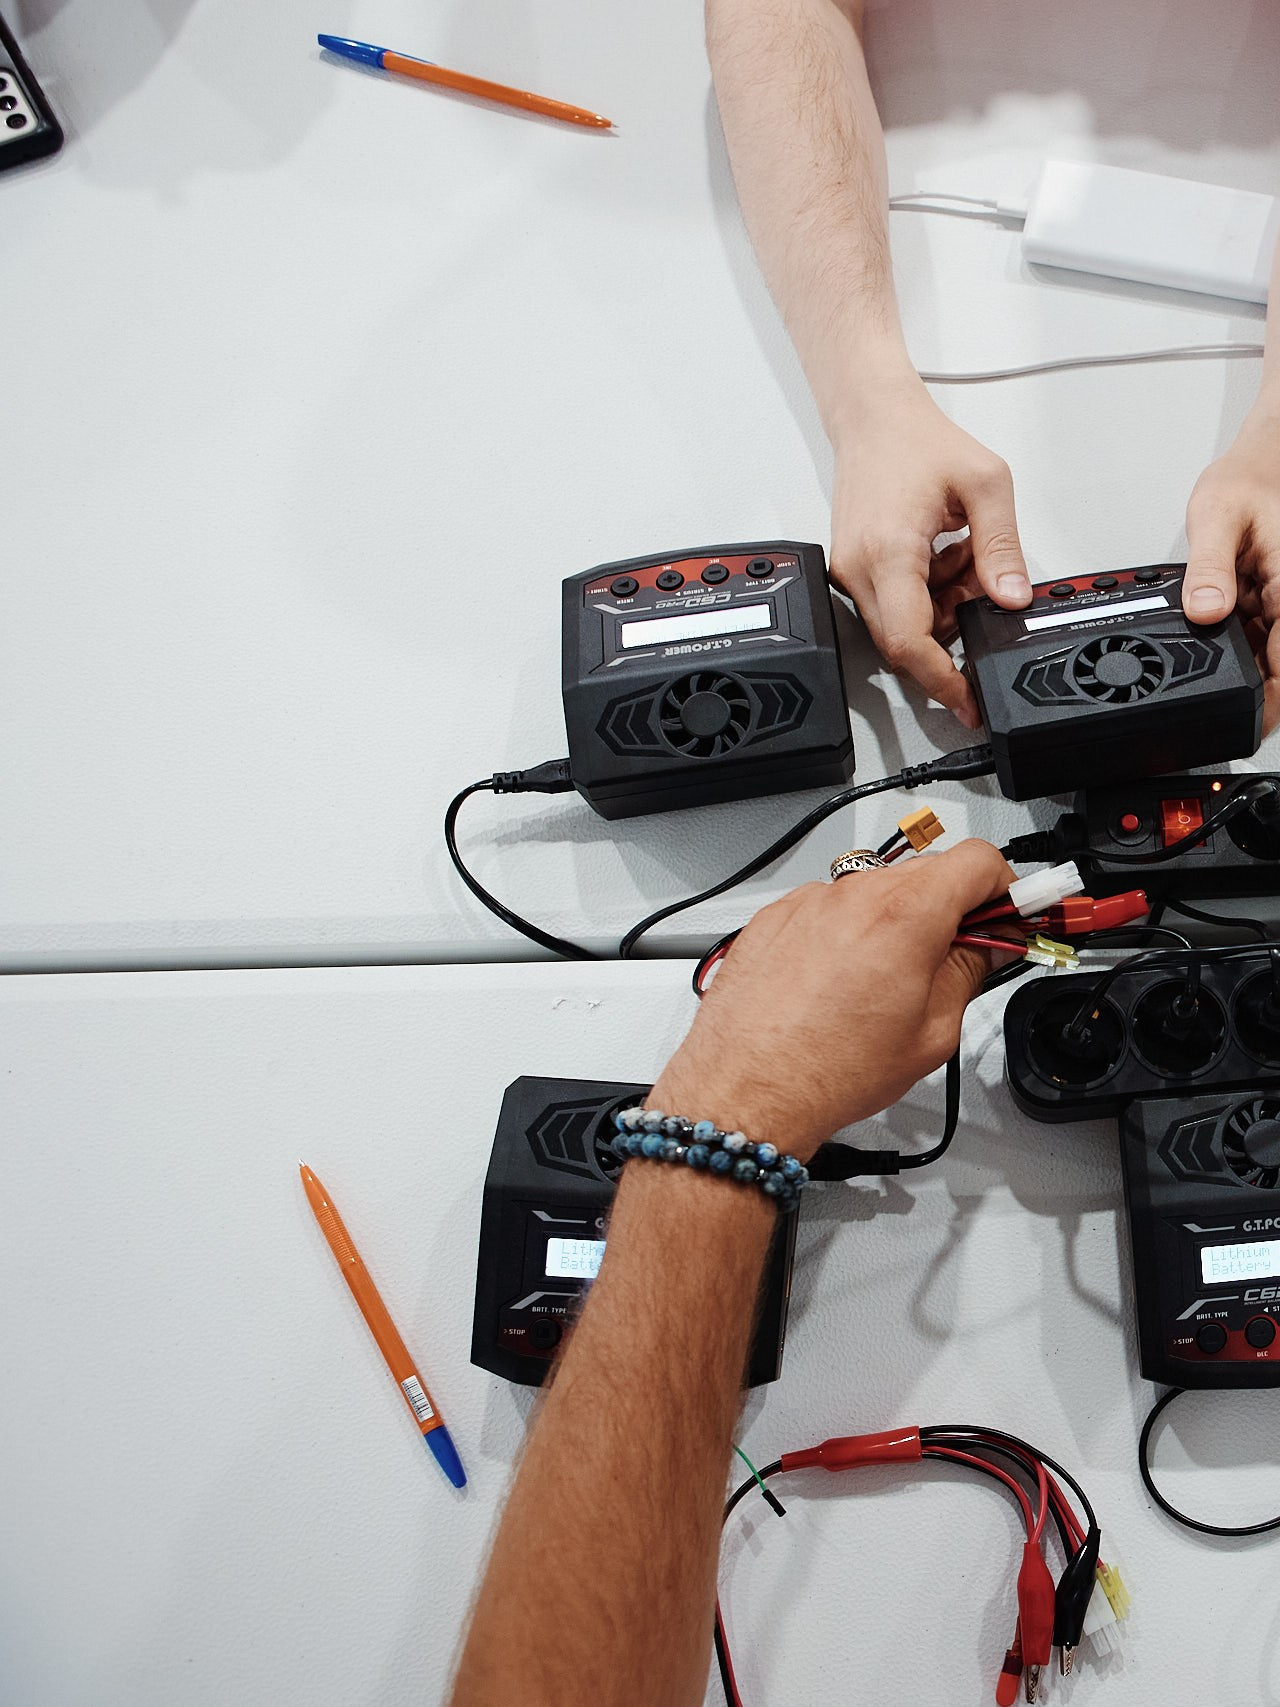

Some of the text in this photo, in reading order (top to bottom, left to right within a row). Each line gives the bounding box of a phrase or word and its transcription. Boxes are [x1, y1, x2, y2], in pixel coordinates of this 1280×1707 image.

[1070, 615, 1135, 631] G.T.POWER
[665, 639, 733, 657] G.T.POWER
[1211, 1246, 1271, 1262] Lithium
[1211, 1261, 1271, 1276] Battery
[1214, 1311, 1229, 1319] TYPE
